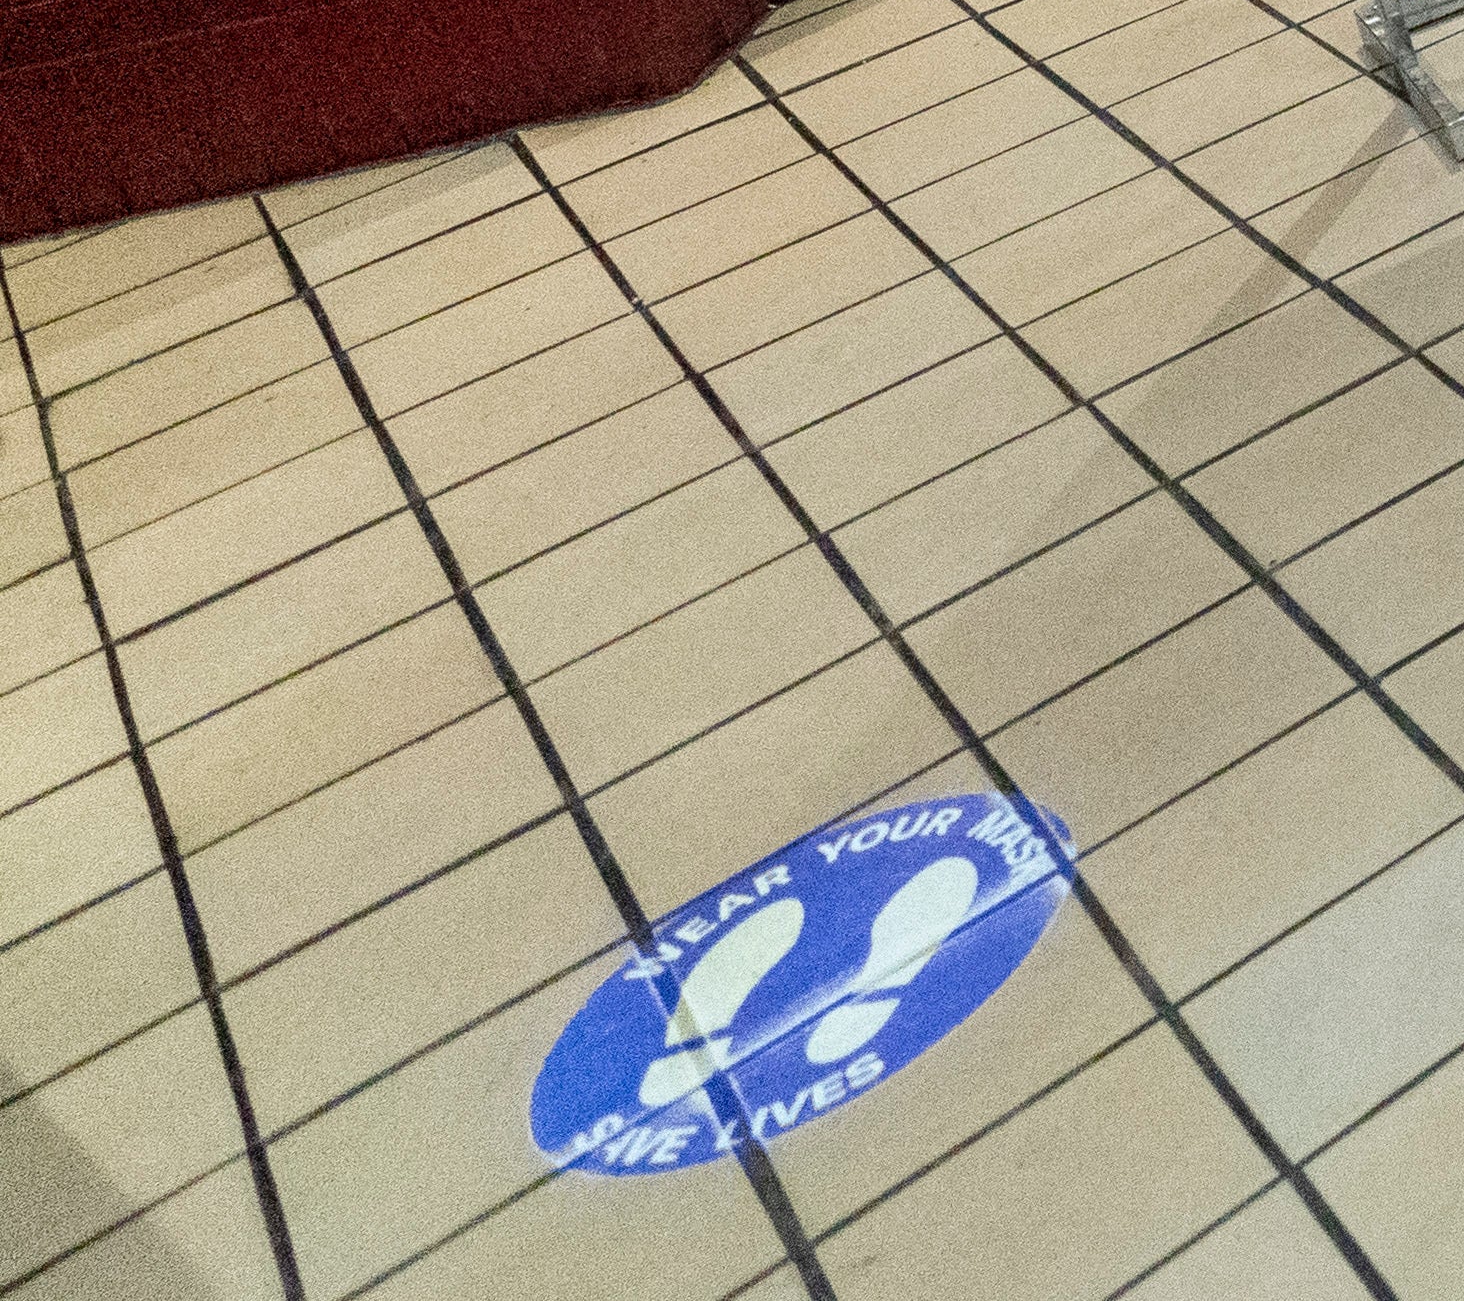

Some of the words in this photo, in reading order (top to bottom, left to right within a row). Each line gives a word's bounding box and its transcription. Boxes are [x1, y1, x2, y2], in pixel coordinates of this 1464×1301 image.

[622, 863, 792, 972] WEAR
[816, 806, 964, 864] YOUR
[713, 1051, 886, 1151] LIVES
